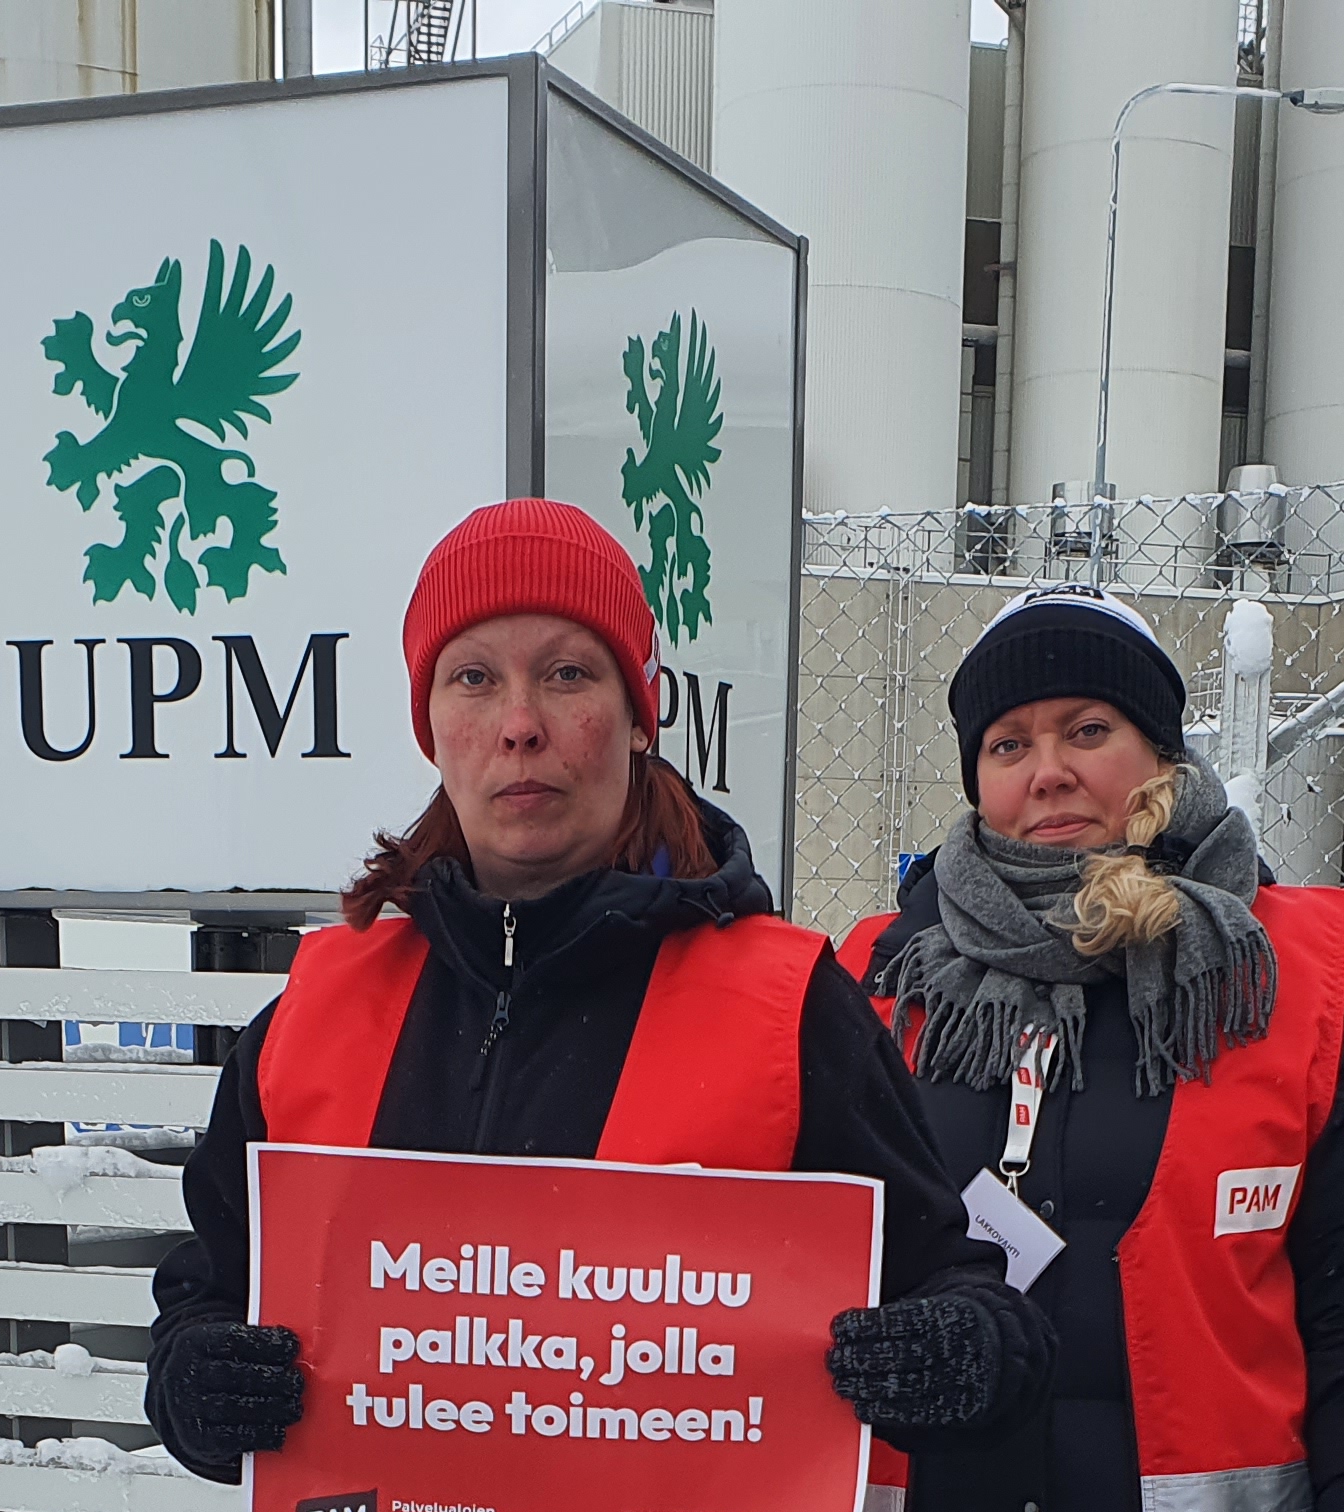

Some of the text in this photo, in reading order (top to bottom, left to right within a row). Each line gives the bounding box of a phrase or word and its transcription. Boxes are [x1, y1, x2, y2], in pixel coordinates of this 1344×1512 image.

[6, 632, 351, 762] UPM
[651, 666, 733, 794] PM
[1228, 1184, 1281, 1215] PAM
[975, 1215, 1020, 1258] LAKKOVAHTI
[370, 1241, 751, 1307] Meille kuuluu
[379, 1317, 735, 1386] palkka, jolla
[347, 1384, 764, 1443] tulee toimeen!
